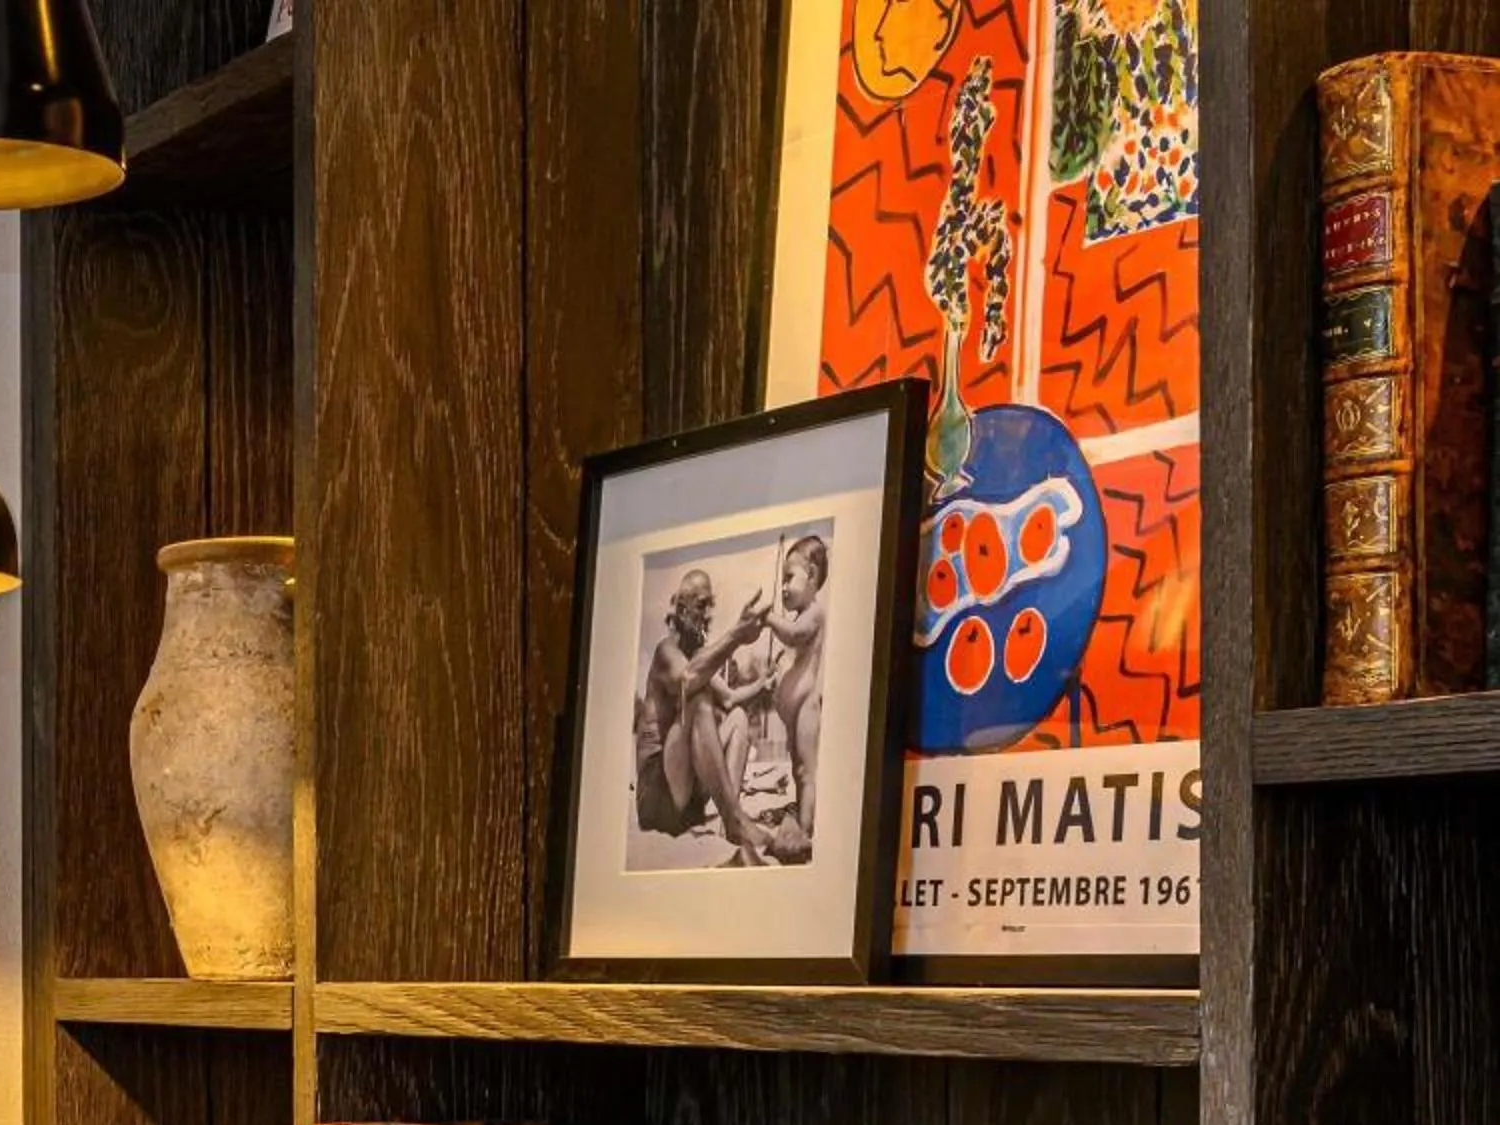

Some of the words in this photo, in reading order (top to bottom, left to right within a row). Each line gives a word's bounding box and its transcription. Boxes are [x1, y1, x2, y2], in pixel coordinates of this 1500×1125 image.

[911, 783, 966, 849] RI
[896, 878, 944, 908] LET
[966, 875, 1127, 908] SEPTEMBRE
[1139, 875, 1202, 906] 196
